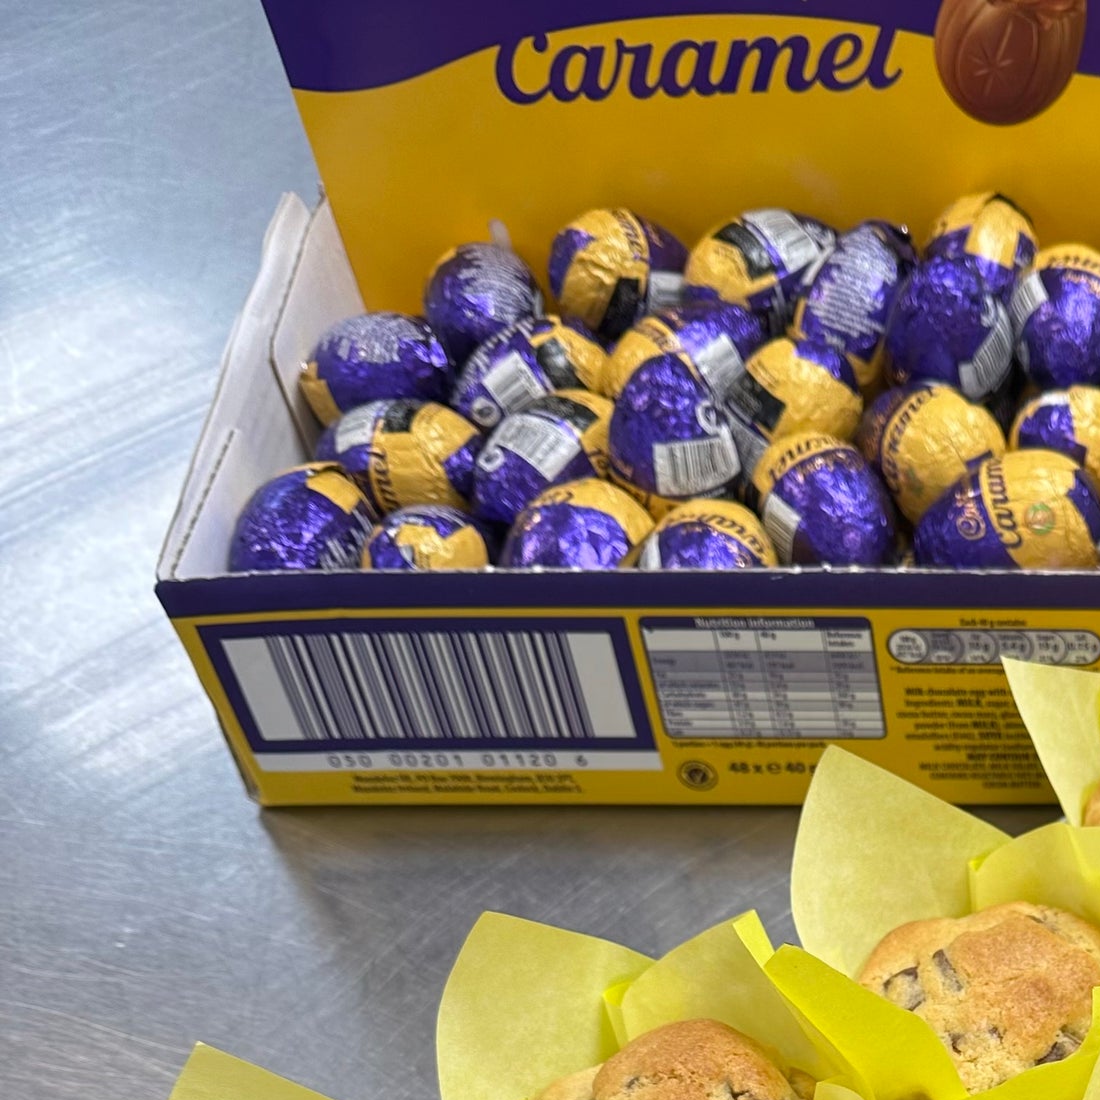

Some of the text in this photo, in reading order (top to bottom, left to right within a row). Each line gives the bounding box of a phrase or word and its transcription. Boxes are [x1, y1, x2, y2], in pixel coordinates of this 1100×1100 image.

[494, 26, 903, 105] Caramel
[328, 752, 588, 768] 050 00201 01120 6
